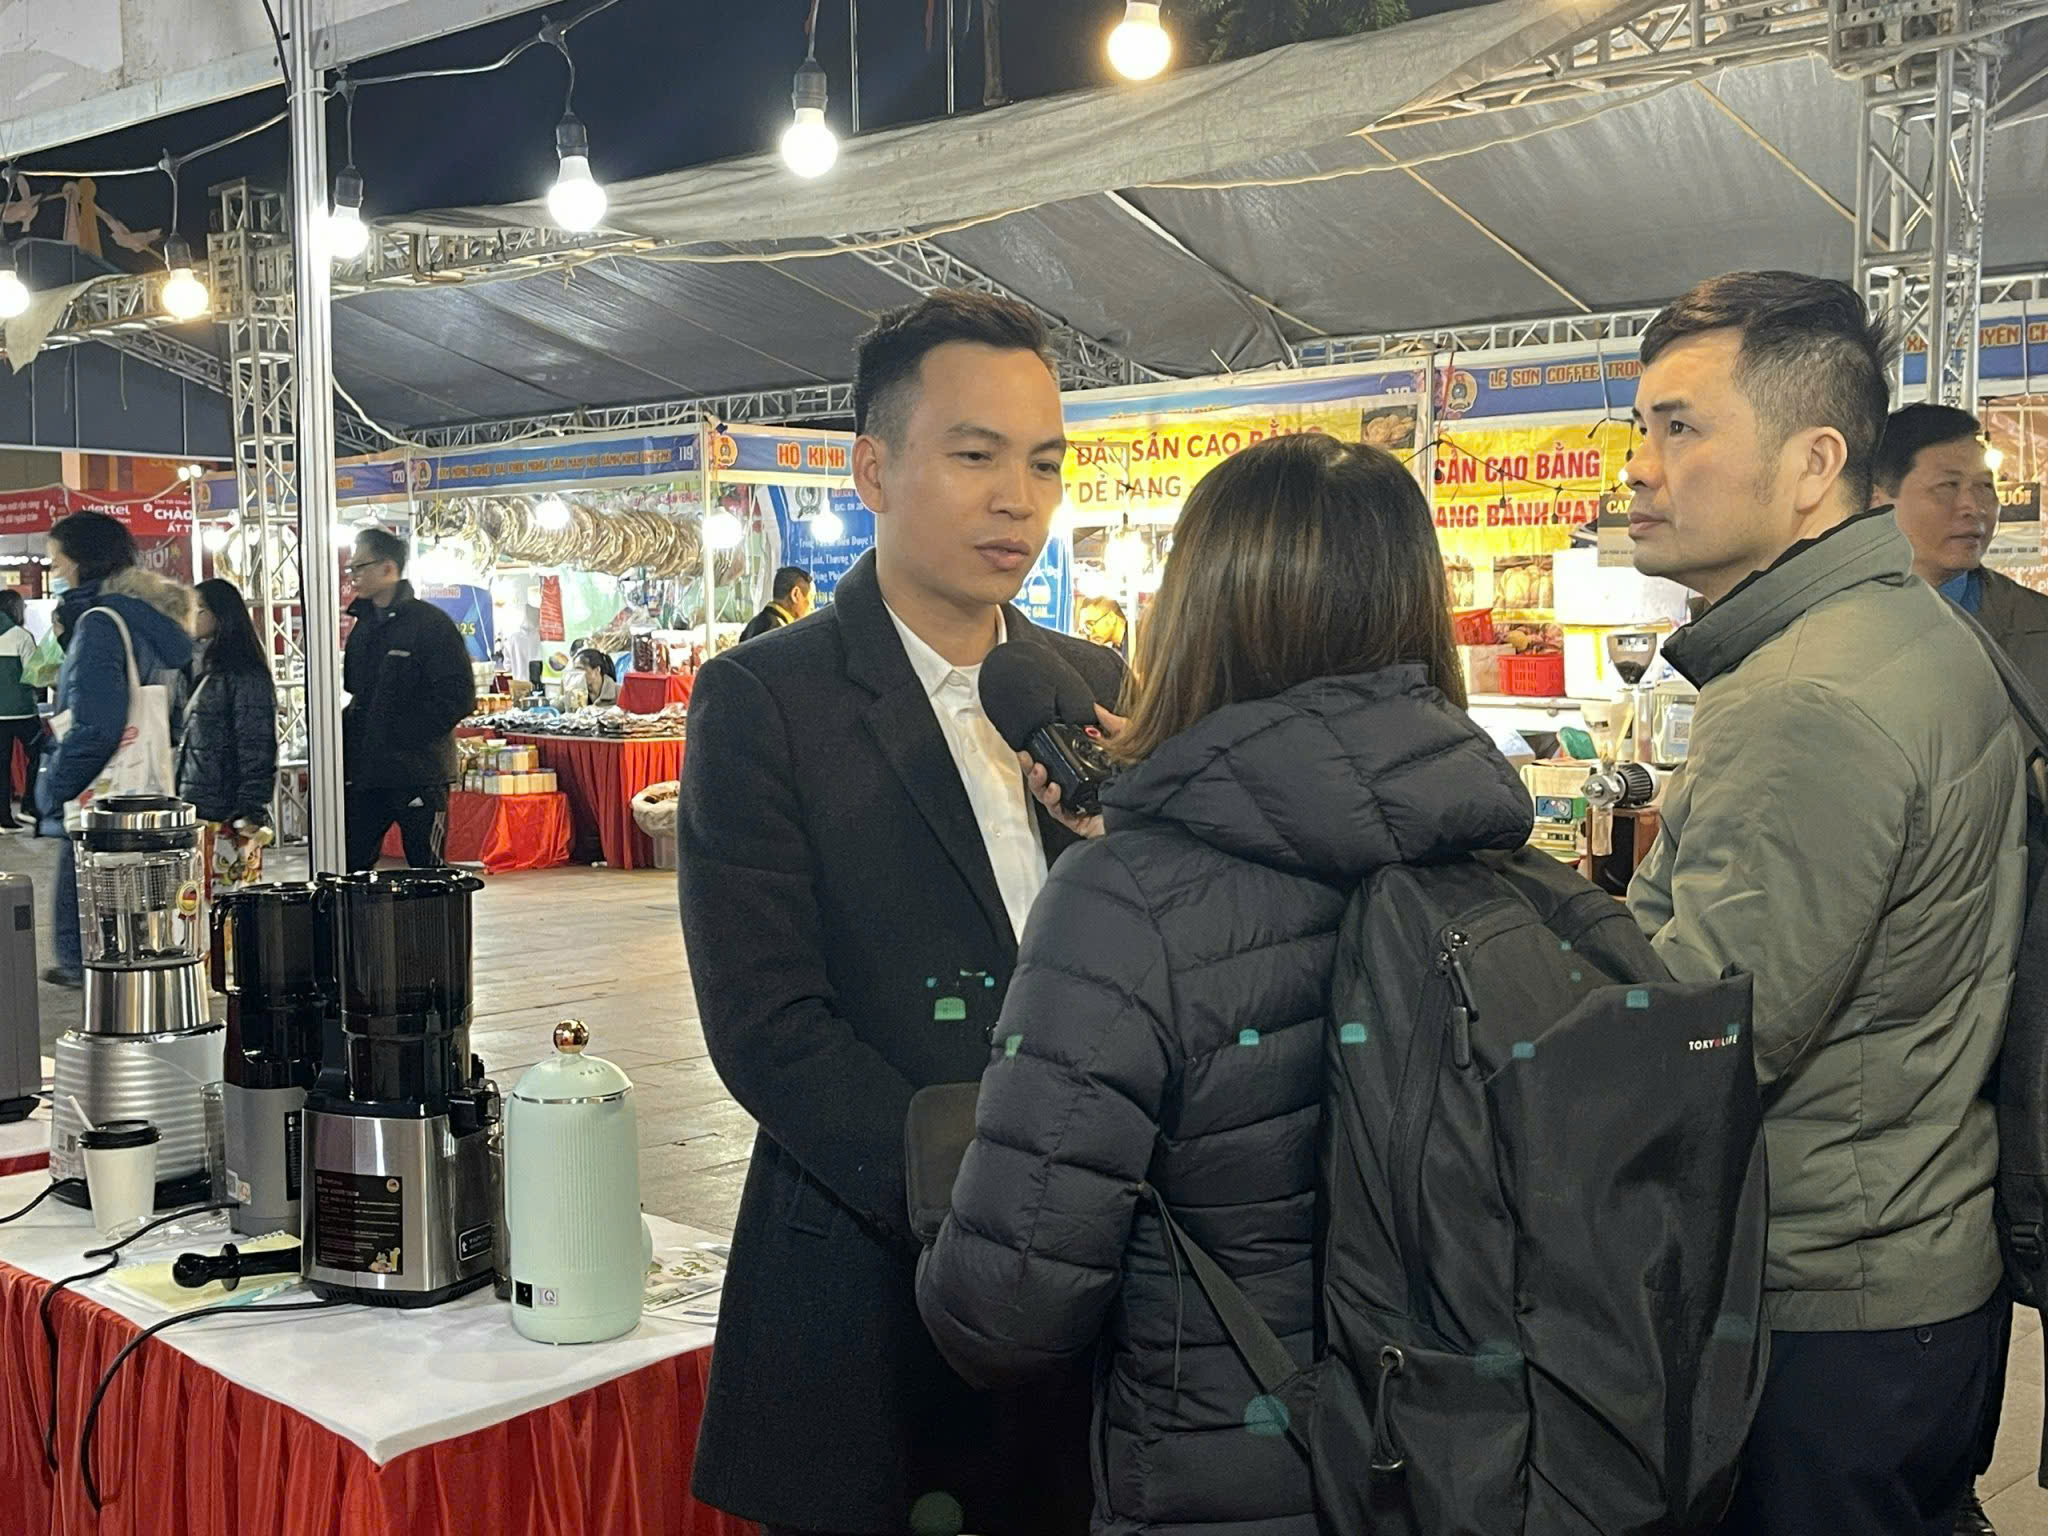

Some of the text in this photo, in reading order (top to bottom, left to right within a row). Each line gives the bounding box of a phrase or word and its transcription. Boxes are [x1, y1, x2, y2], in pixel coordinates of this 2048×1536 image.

[1546, 363, 1599, 383] COFFEE
[678, 446, 694, 461] 119
[807, 445, 846, 469] KINH
[1131, 432, 1179, 462] SẢN
[1186, 432, 1240, 458] CAO
[1485, 456, 1528, 483] CAO
[1536, 442, 1600, 480] BẰNG
[392, 470, 405, 483] 120
[154, 506, 193, 520] CHÀO
[1487, 497, 1549, 527] BÁNH
